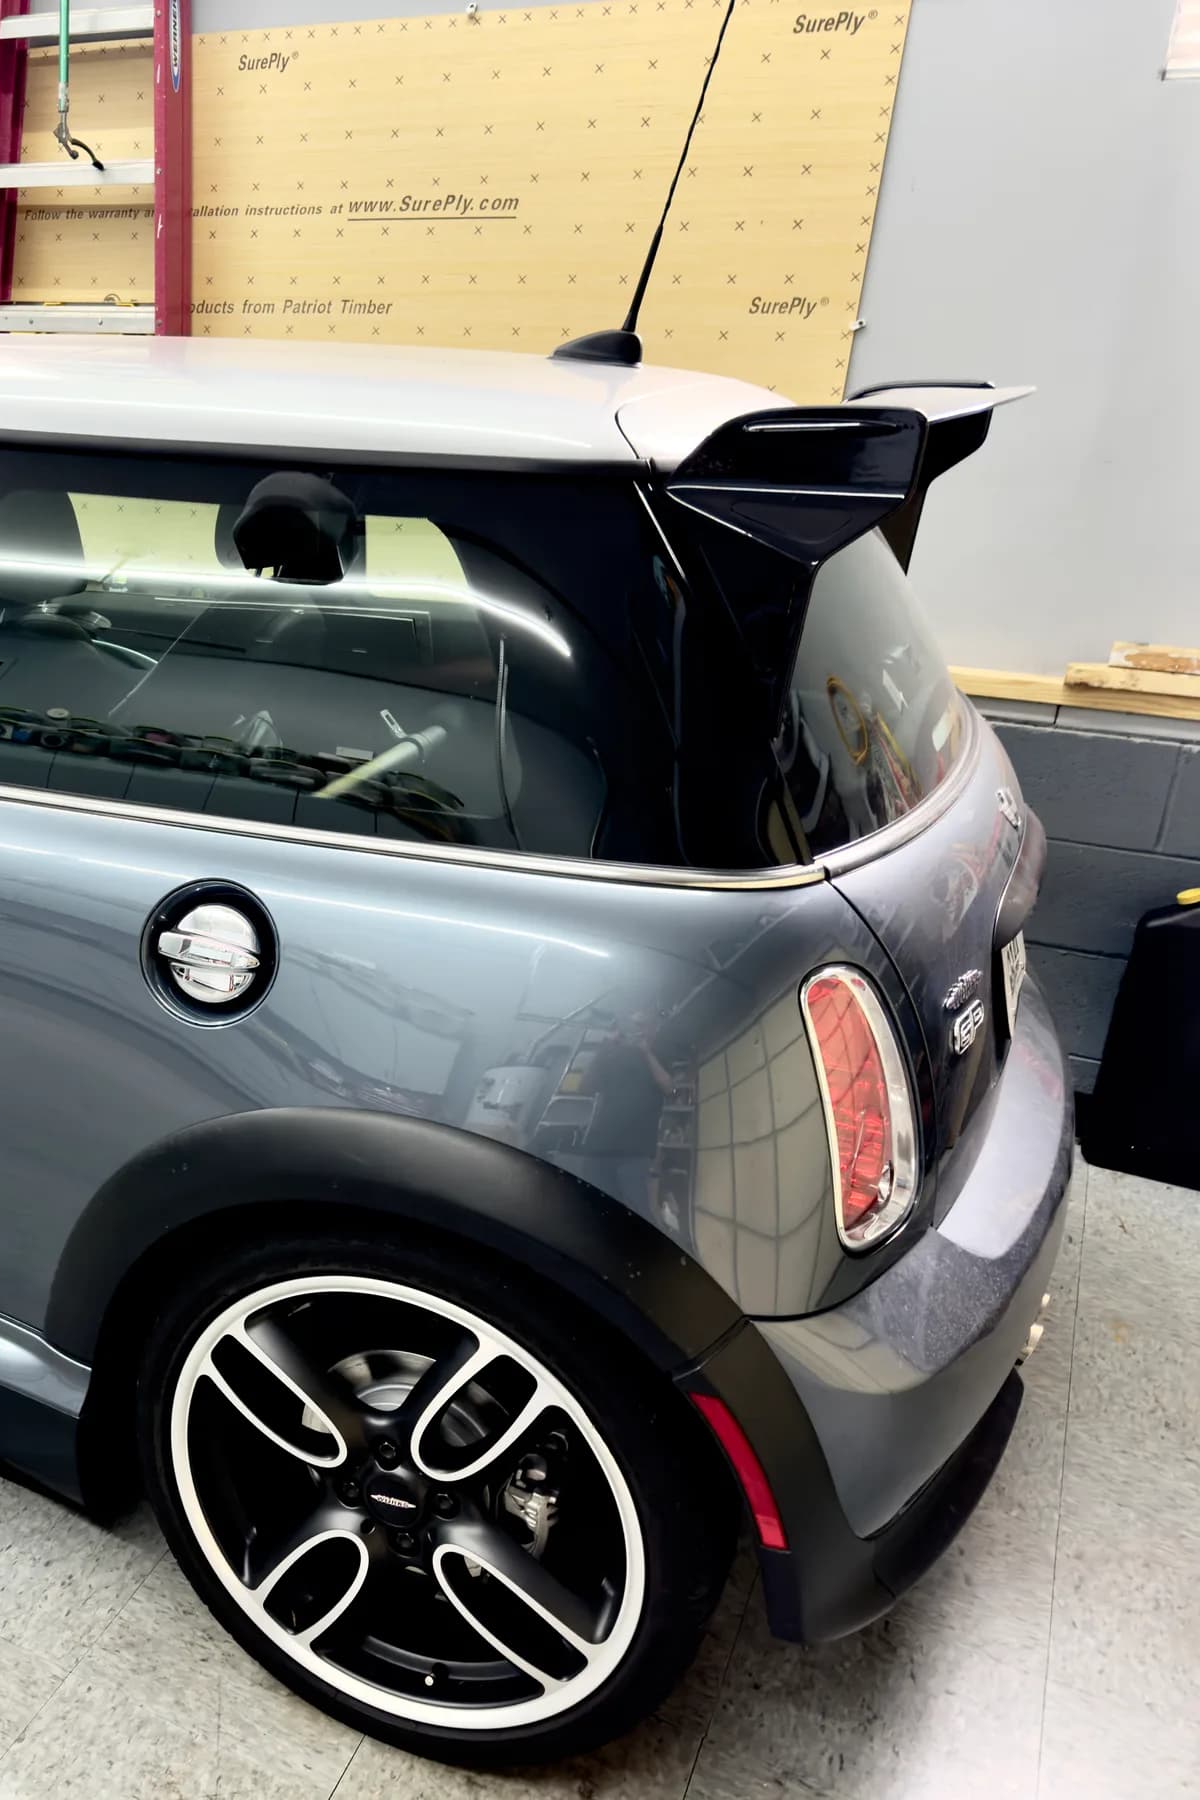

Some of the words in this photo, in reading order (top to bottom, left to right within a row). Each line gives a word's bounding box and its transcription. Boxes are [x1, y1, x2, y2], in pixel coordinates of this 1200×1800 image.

[24, 209, 62, 221] Follow
[65, 208, 84, 220] the
[88, 207, 140, 221] warranty
[191, 204, 239, 217] allation
[245, 203, 323, 216] instructions
[330, 203, 344, 215] at
[349, 193, 520, 216] www.SurePly.com
[189, 299, 234, 315] oducts
[242, 299, 275, 315] from
[282, 298, 333, 315] Patriot
[340, 298, 393, 315] Timber
